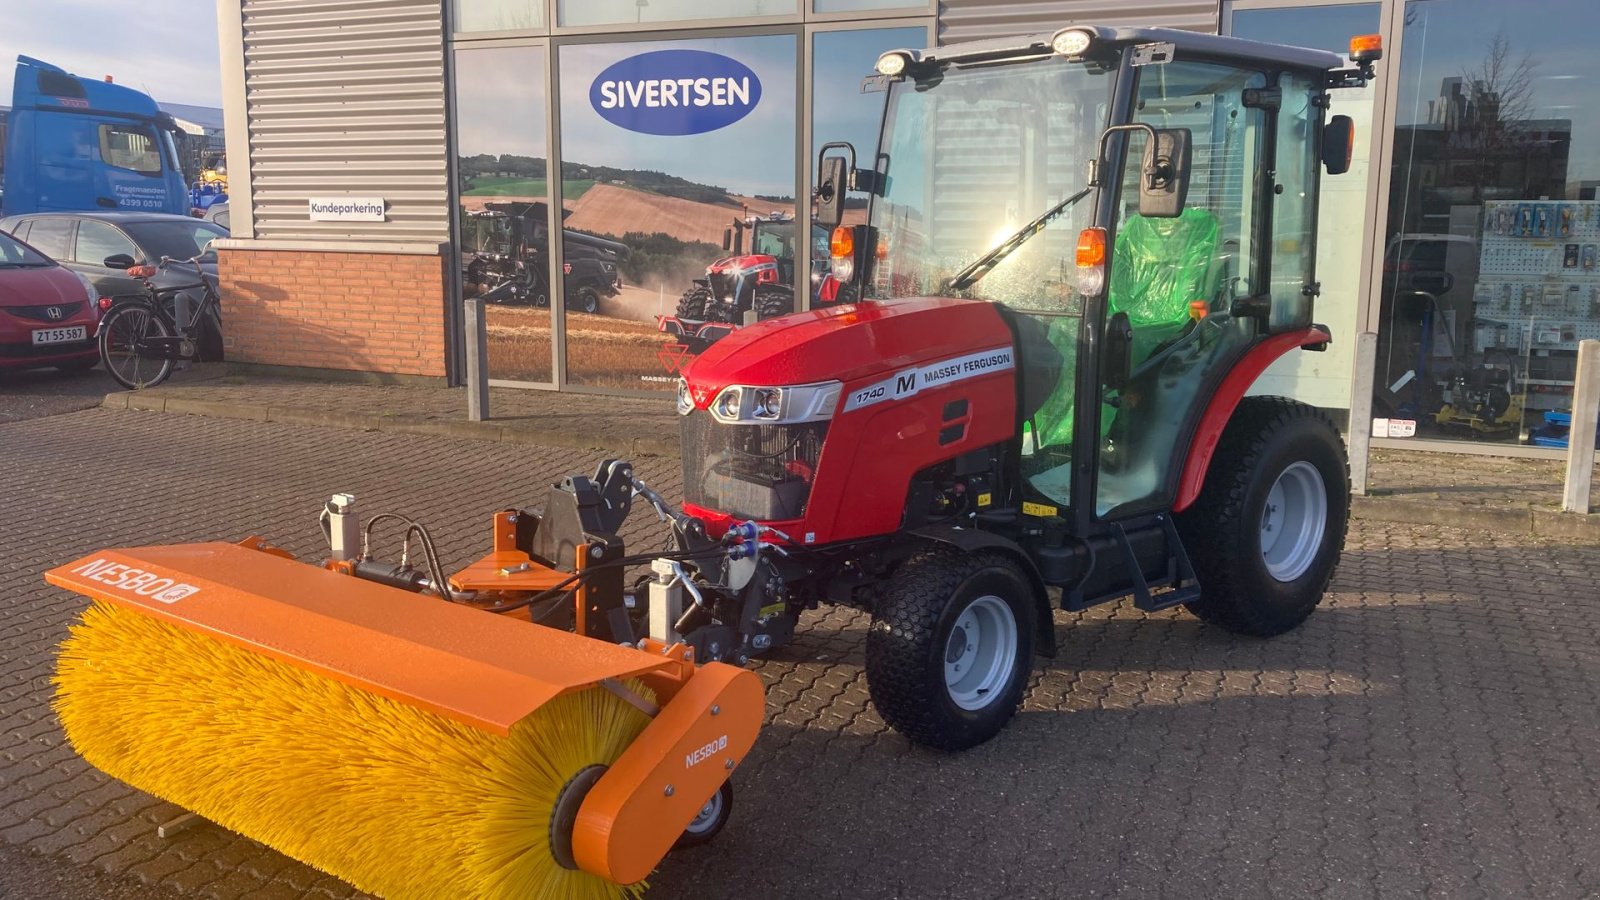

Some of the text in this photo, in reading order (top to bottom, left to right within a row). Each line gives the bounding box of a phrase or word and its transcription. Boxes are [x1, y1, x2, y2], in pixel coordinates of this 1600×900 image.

[600, 76, 750, 109] SIVERTSEN
[120, 198, 141, 207] 4399
[311, 202, 382, 216] Kundeparkering
[37, 329, 83, 342] ZT 55 587
[856, 353, 1010, 403] 1740 M MASSEY FERGUSON
[70, 558, 175, 595] NESBO
[685, 740, 718, 769] NESBO
